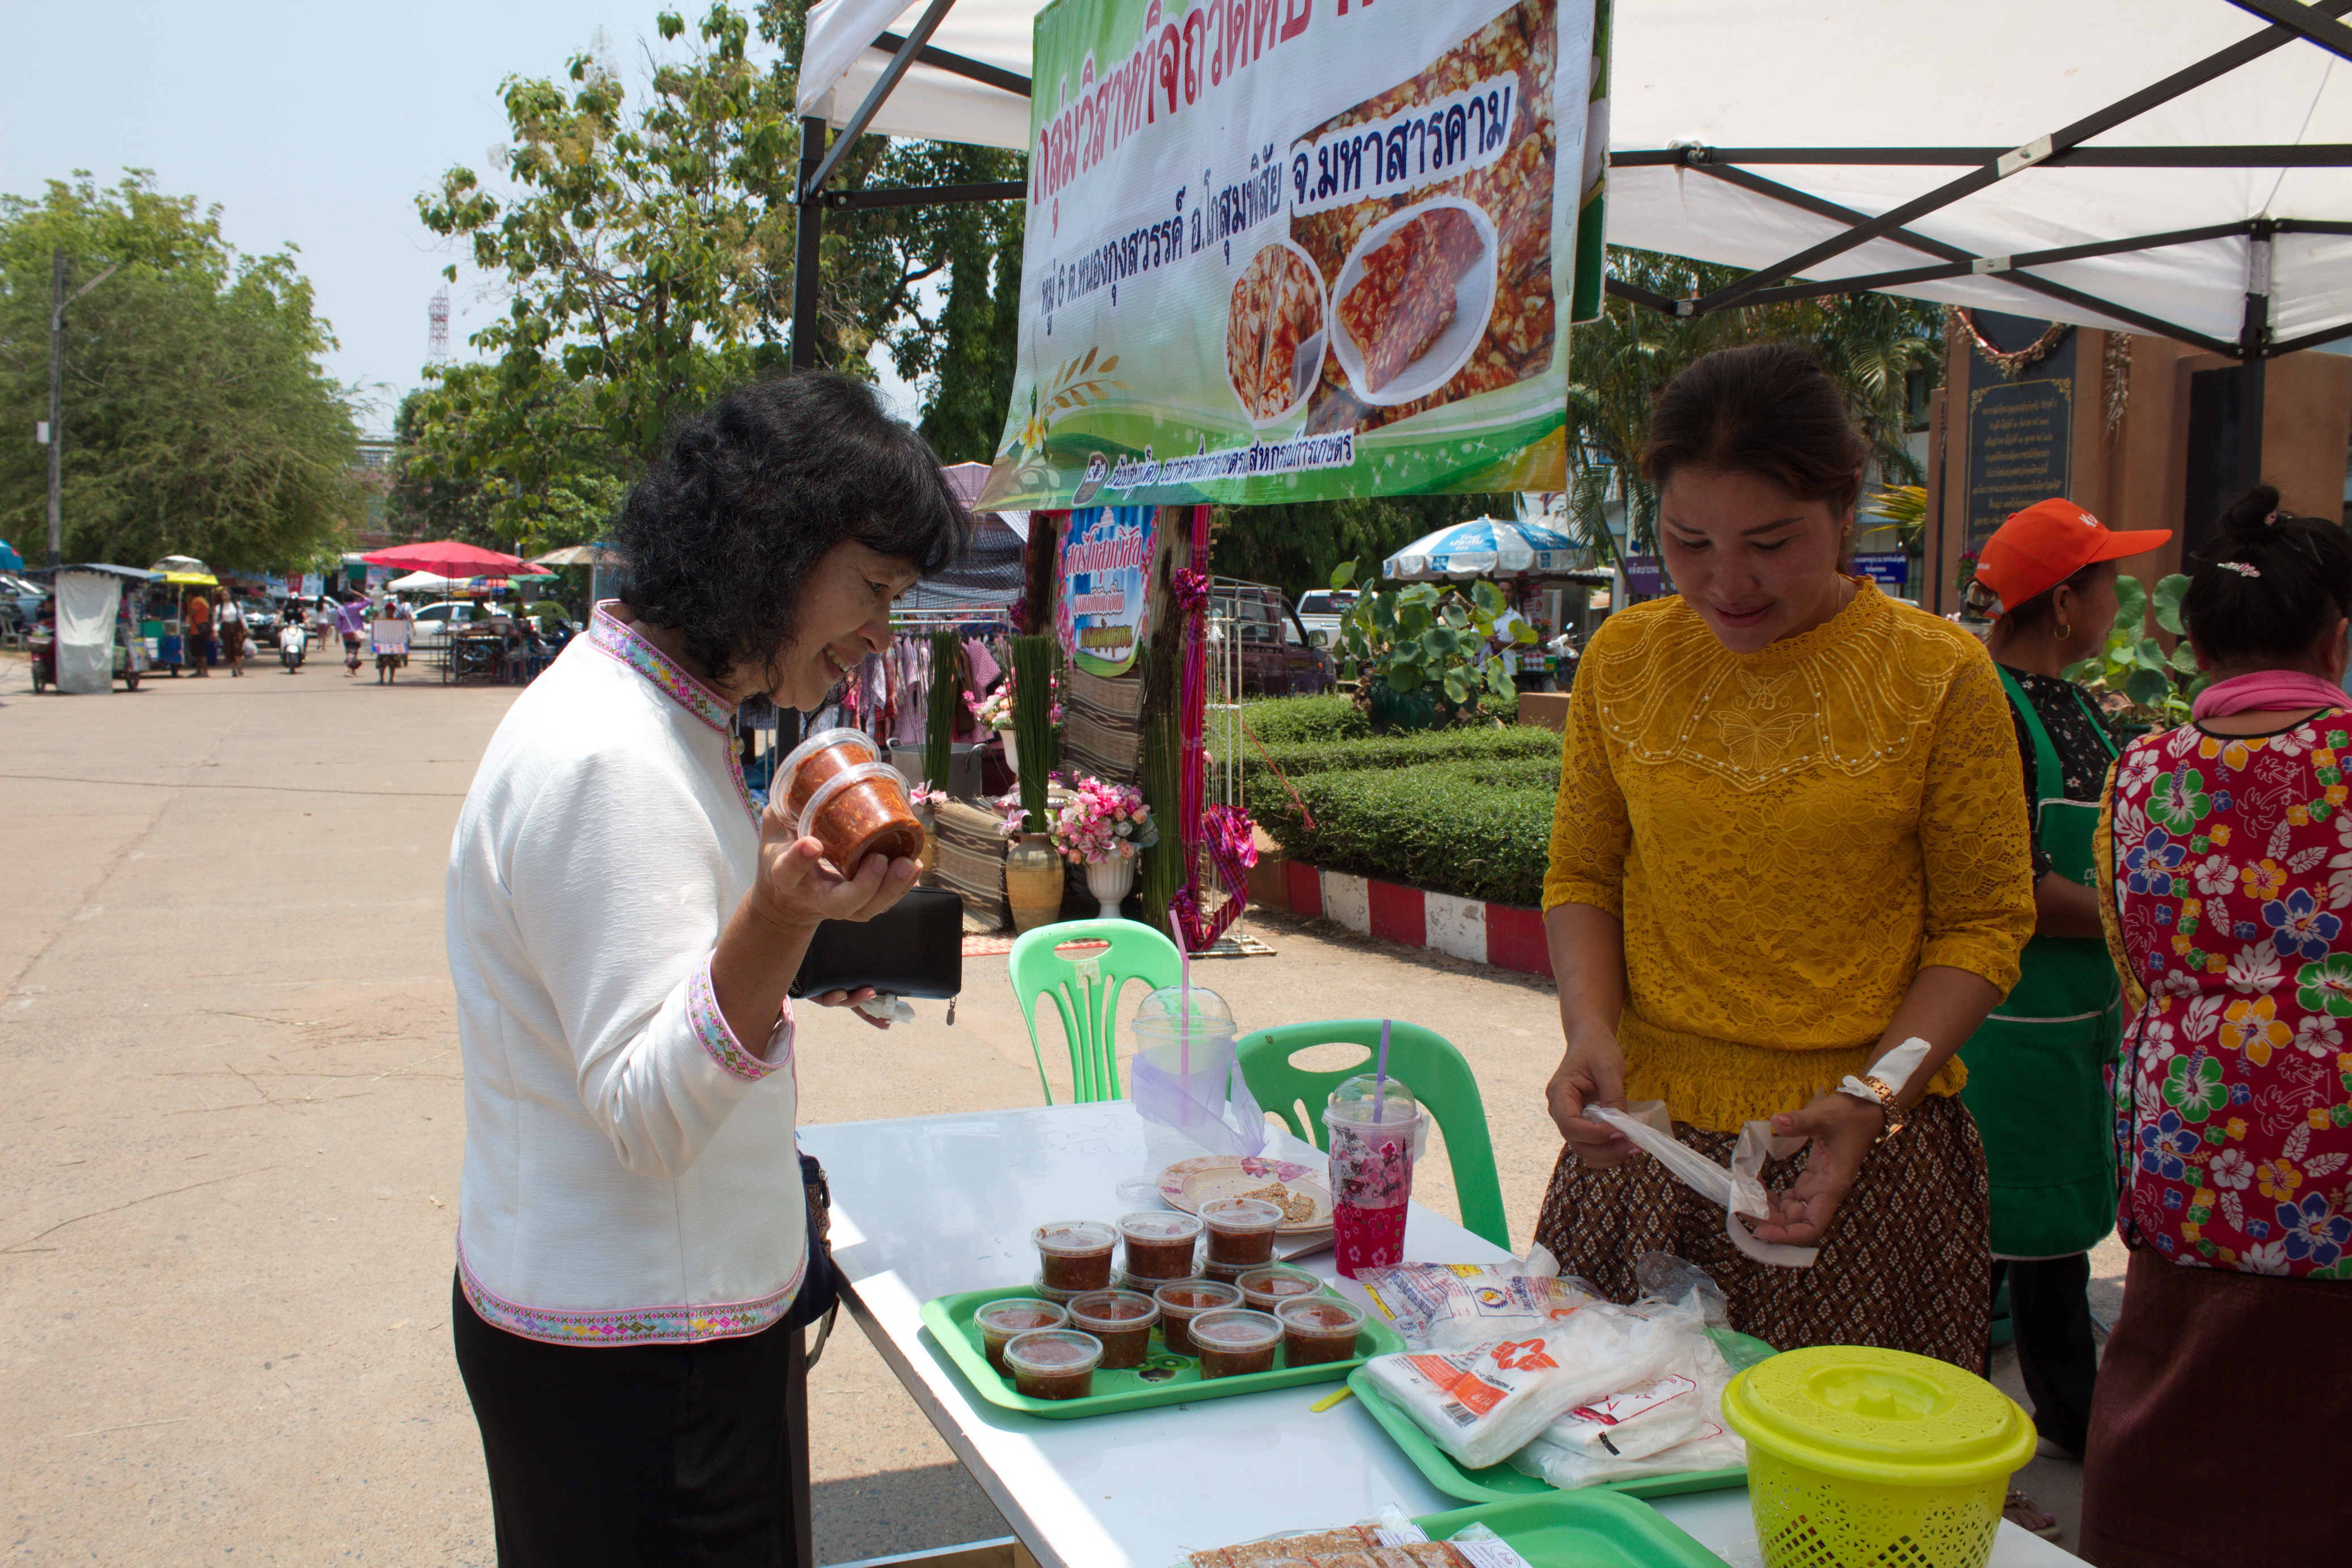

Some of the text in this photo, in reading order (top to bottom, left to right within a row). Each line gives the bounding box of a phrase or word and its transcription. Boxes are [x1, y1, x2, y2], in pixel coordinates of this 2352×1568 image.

[1041, 86, 1510, 336] หมู่ 6 ต.หนองกุงสวรรค์ อ.โกสุมพิสัย จ.มหาสารคาม
